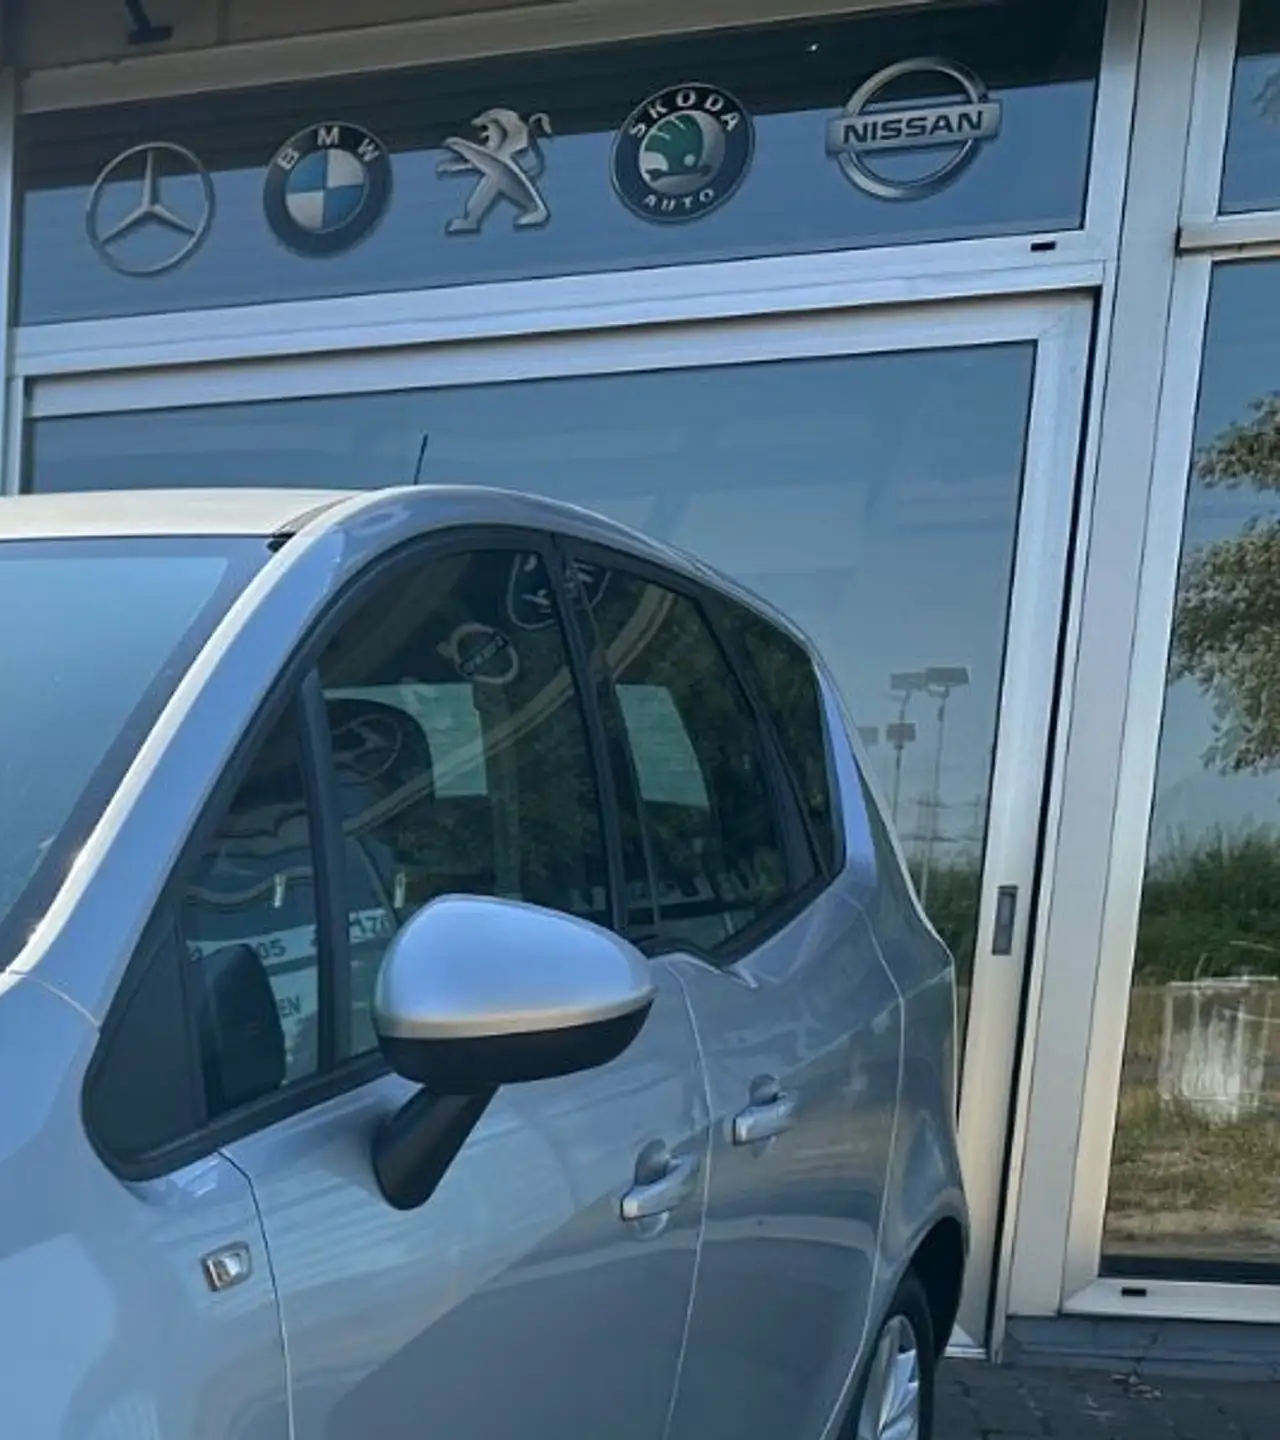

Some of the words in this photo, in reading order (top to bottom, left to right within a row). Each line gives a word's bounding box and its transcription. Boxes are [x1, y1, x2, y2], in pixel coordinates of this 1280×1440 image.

[842, 109, 984, 145] NISSAN
[276, 126, 381, 171] BMW
[643, 187, 715, 211] AUTO
